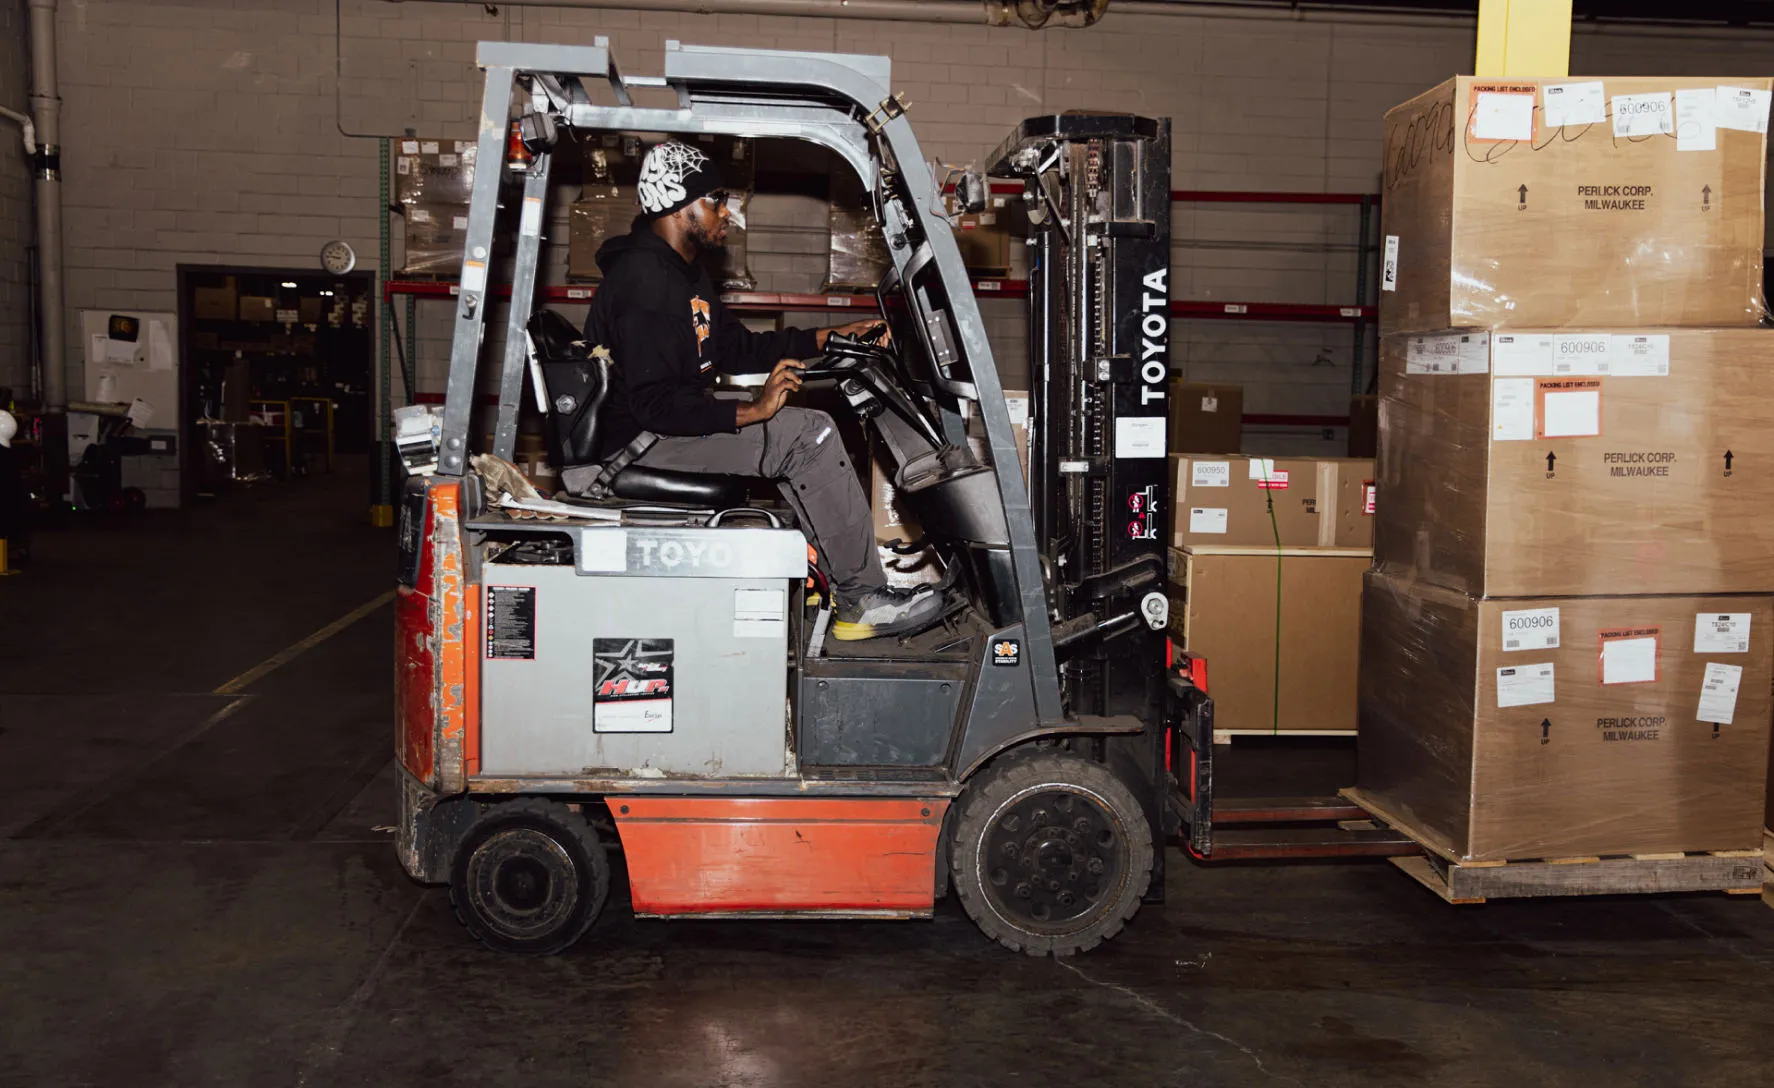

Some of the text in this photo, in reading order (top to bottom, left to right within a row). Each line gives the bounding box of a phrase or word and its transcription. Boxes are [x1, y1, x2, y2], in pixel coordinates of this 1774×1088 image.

[1619, 100, 1666, 115] 600906
[1577, 186, 1654, 197] PERLICK CORP.
[1584, 200, 1645, 211] MILWAUKEE
[1141, 267, 1167, 405] TOYOTA
[1560, 341, 1606, 354] 600906
[1604, 452, 1677, 464] PERLICK CORP.
[1197, 466, 1226, 474] 600950
[1610, 466, 1669, 477] MILWAUKEE
[1302, 498, 1316, 506] PER
[1509, 616, 1554, 630] 600906
[994, 641, 1019, 656] SAS
[1597, 718, 1637, 729] PERLICK
[1603, 730, 1659, 742] MILWAUKEE
